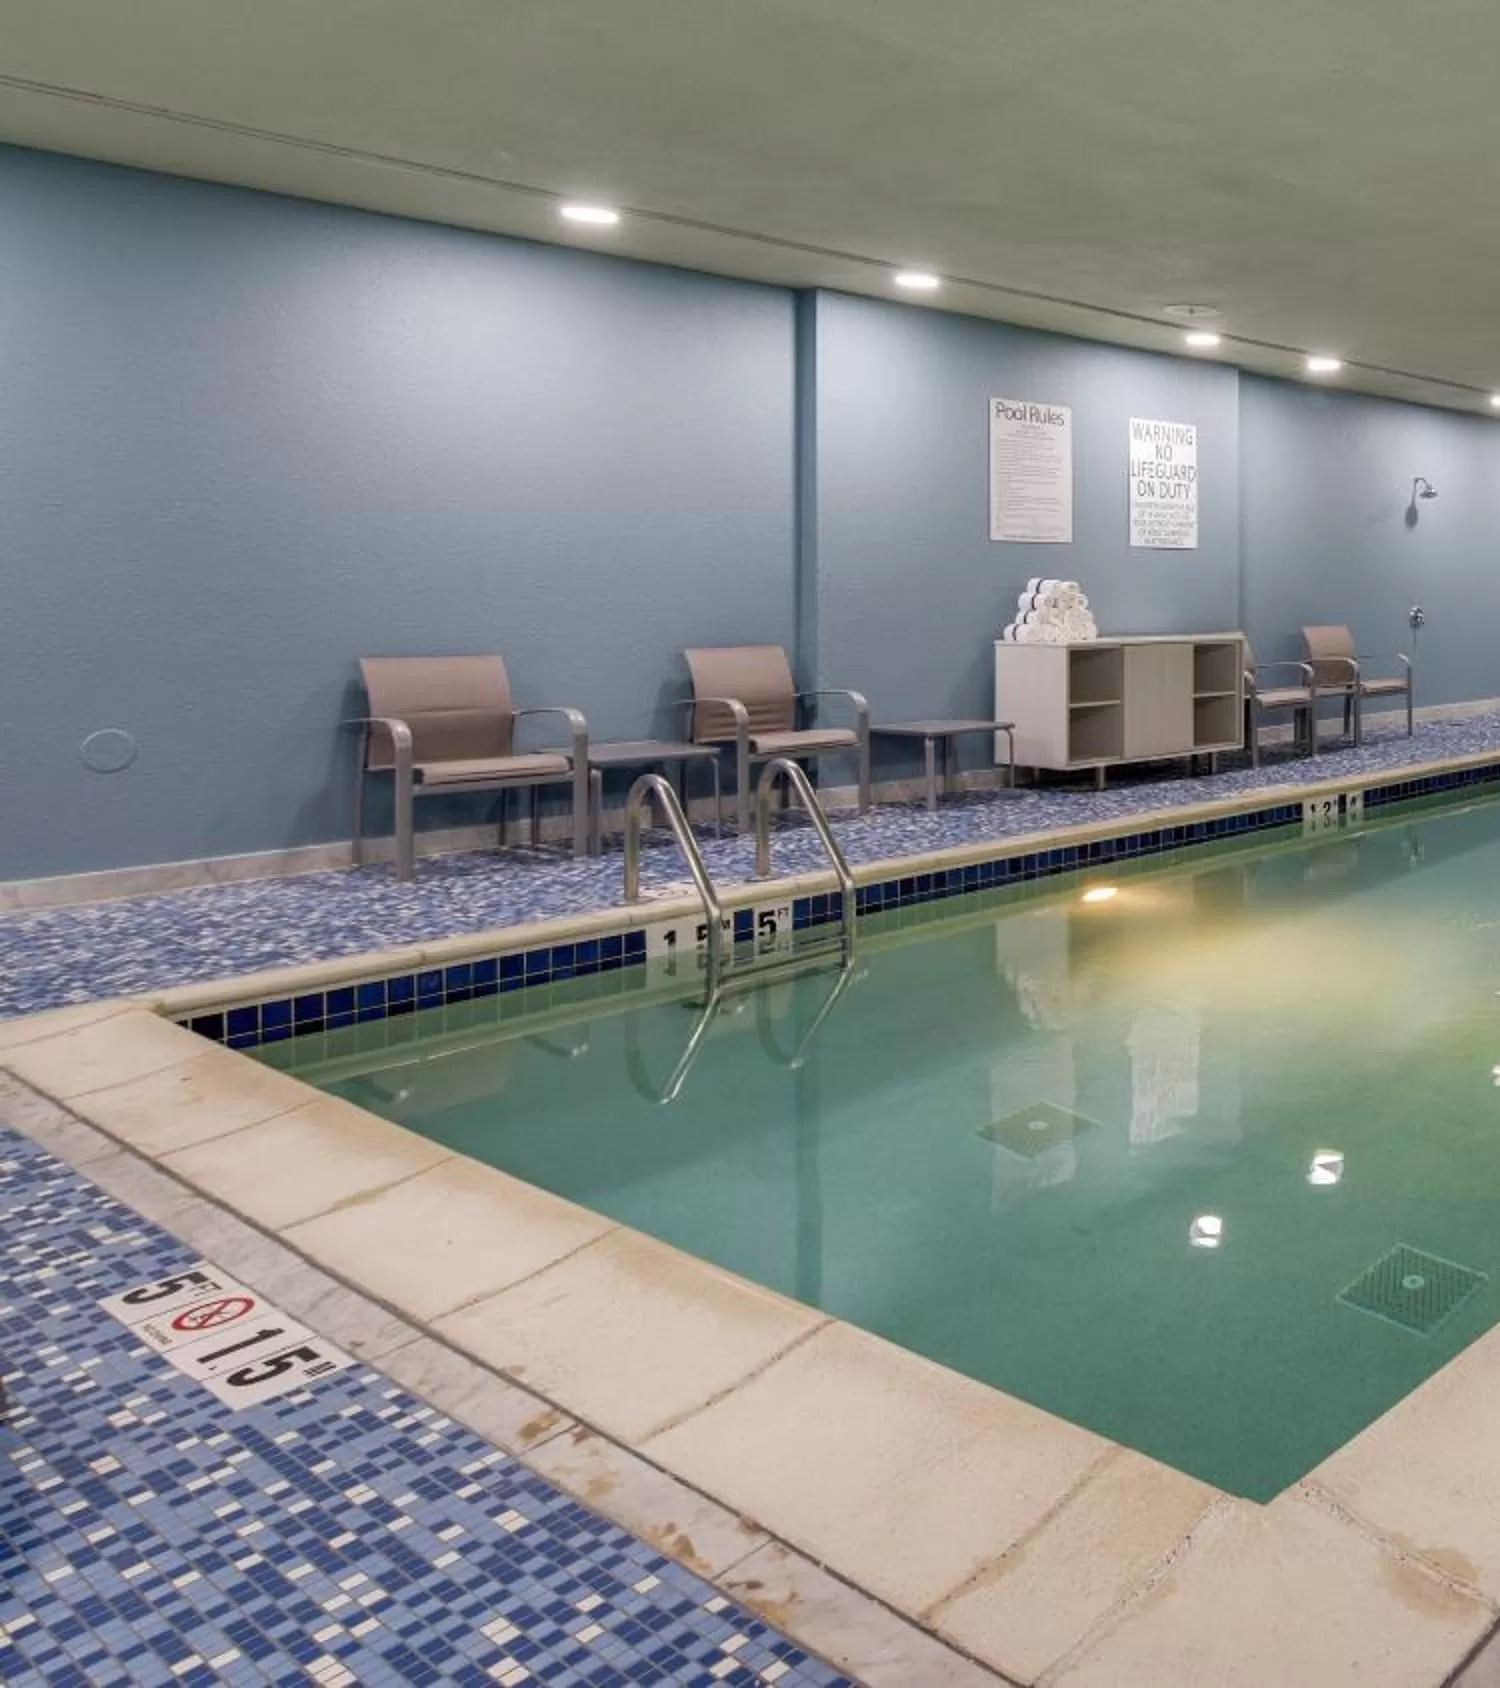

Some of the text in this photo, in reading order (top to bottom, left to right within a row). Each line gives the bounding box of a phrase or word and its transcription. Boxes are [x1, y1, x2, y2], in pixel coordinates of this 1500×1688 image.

[995, 401, 1065, 426] Pool Rules
[1131, 421, 1194, 446] WARNING
[1154, 445, 1173, 462] NO
[1130, 460, 1197, 483] LIFEGUARD
[1137, 480, 1191, 499] ON DUTY
[122, 1270, 210, 1306] 5
